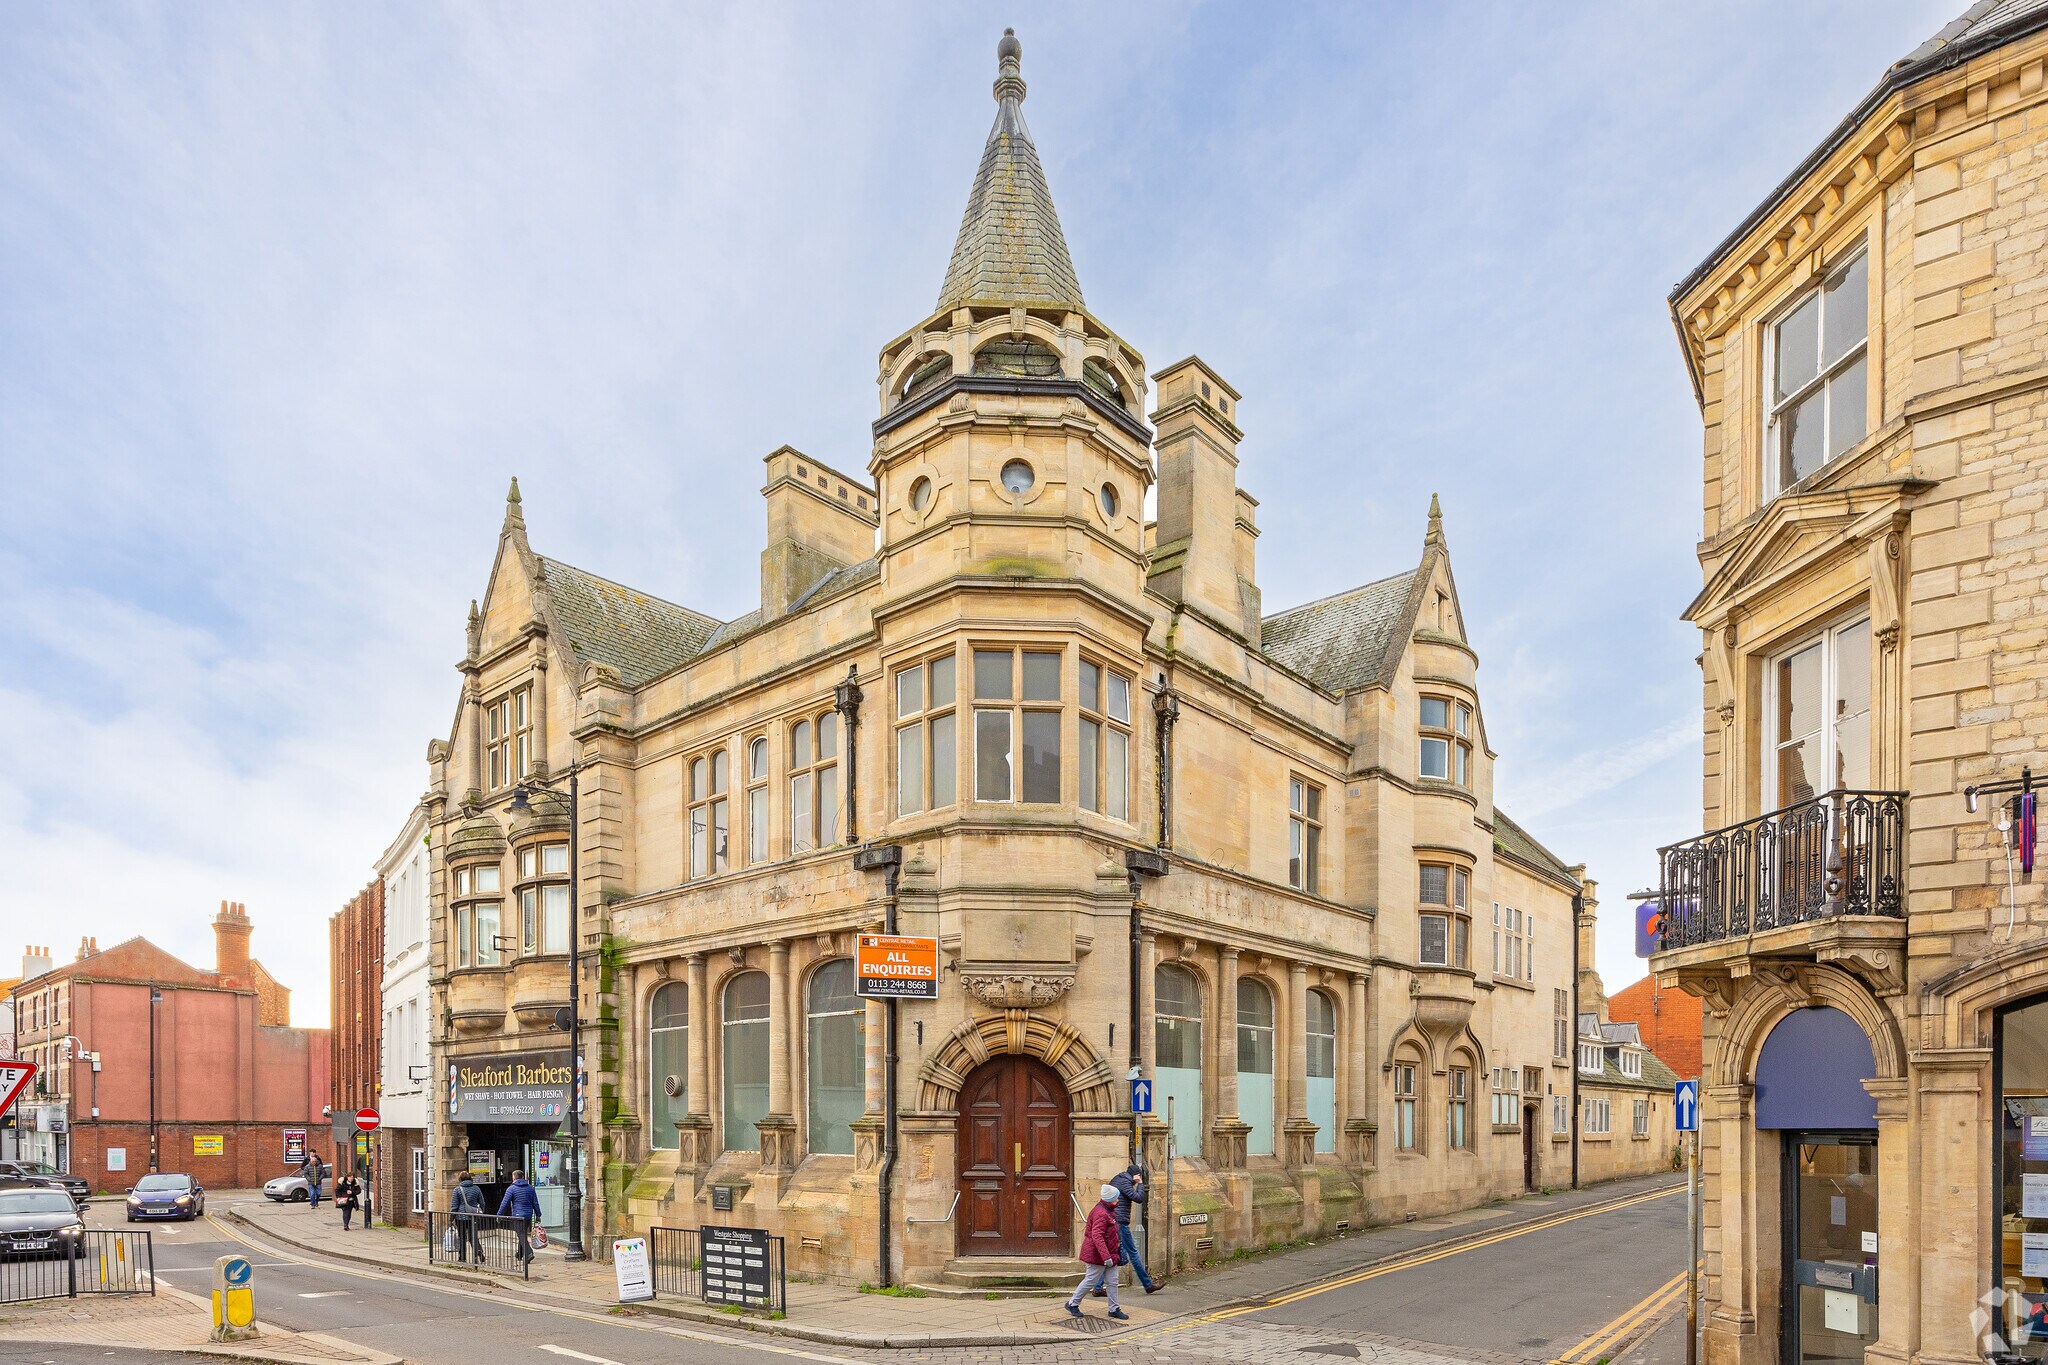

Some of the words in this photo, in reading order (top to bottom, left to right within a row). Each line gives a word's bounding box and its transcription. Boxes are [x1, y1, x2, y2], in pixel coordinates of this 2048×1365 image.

[886, 952, 910, 962] ALL
[863, 963, 932, 976] ENQUIRIES
[868, 979, 888, 988] 0113
[890, 980, 905, 988] 244
[907, 981, 927, 989] 8668
[460, 1064, 512, 1088] Sleaford
[516, 1062, 572, 1085] Barbers
[464, 1092, 475, 1100] WET
[475, 1092, 490, 1100] SHAVE
[493, 1091, 506, 1100] HOT
[506, 1091, 523, 1099] TOWEL
[527, 1090, 541, 1099] HAIR
[542, 1089, 564, 1099] DESIGN
[1181, 1214, 1206, 1224] WESTGATE
[713, 1230, 732, 1239] Westgate
[732, 1231, 753, 1242] Shopping
